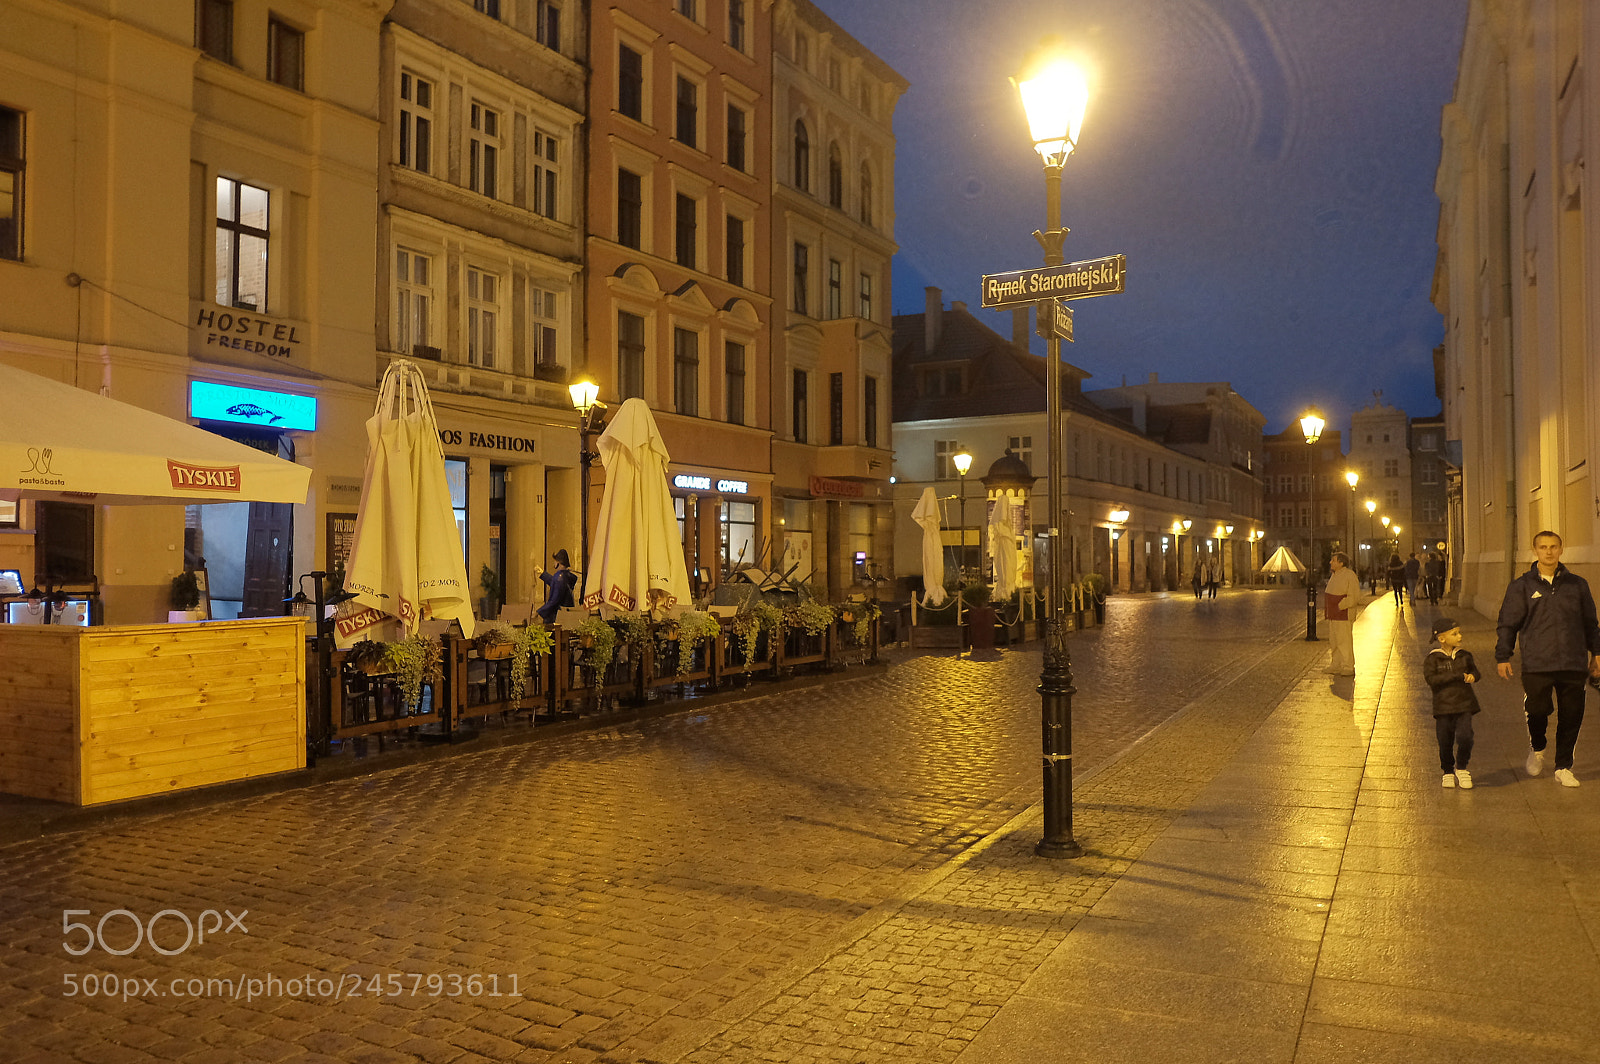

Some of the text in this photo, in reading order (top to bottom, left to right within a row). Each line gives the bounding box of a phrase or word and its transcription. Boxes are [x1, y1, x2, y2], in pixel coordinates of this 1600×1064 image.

[988, 263, 1113, 302] Rynek Staromiejski
[197, 308, 301, 344] HOSTEL
[207, 333, 292, 358] FREEDOM
[469, 432, 535, 453] FASHION
[19, 477, 65, 486] pasta&basta
[172, 465, 237, 488] TYSKIE
[717, 480, 748, 494] COFFEE
[584, 592, 604, 608] YSK
[611, 588, 635, 609] TYSKI
